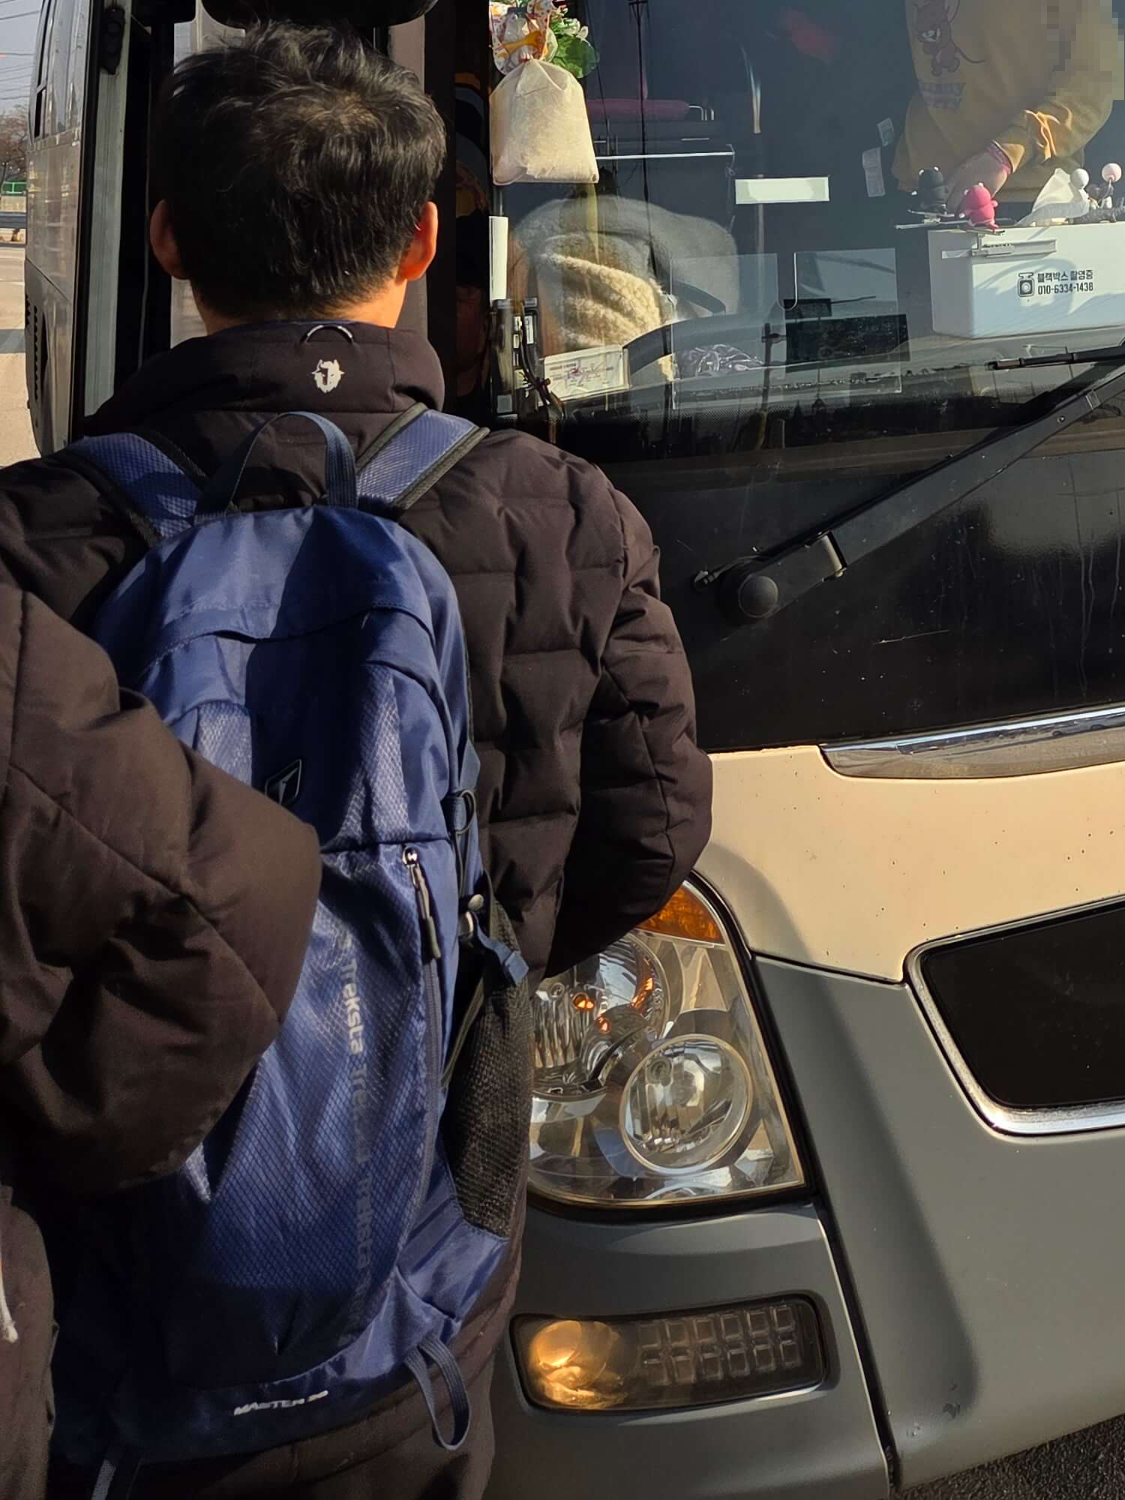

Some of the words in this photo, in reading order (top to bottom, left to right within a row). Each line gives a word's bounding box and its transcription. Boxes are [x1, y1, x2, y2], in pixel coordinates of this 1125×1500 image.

[1037, 271, 1069, 283] 블랙박스
[1037, 282, 1094, 295] 010-6334-1438
[340, 958, 364, 1056] Treksta
